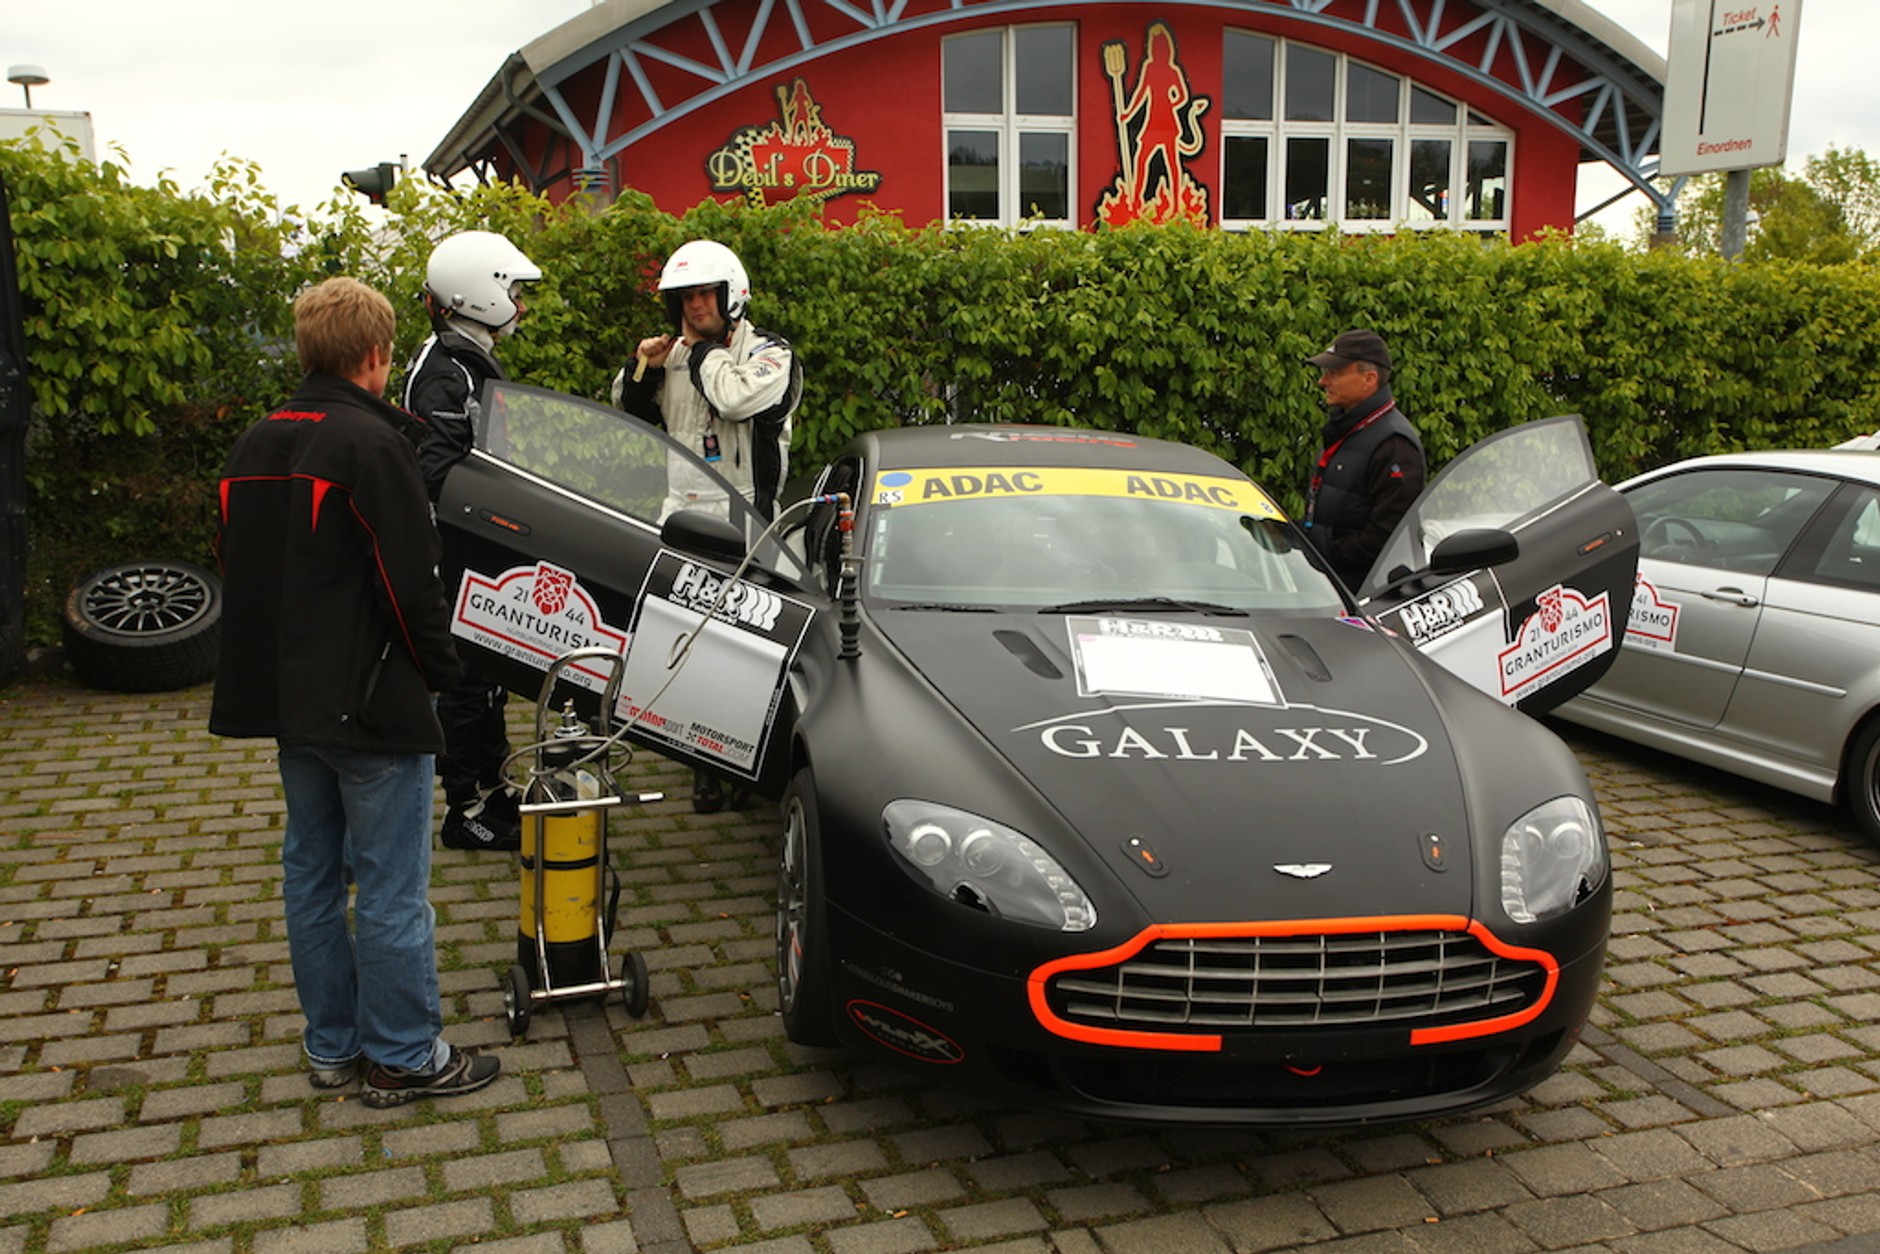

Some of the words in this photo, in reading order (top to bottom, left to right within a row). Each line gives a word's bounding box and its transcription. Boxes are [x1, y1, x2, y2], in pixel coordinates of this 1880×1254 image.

[1723, 8, 1757, 26] Ticket
[1696, 138, 1752, 156] Einordnen
[803, 148, 879, 188] Diner
[922, 472, 1044, 499] ADAC
[1126, 475, 1239, 508] ADAC
[470, 592, 613, 651] GRANTURISM
[514, 586, 529, 604] 21
[565, 608, 585, 627] 44
[1529, 628, 1541, 643] 21
[1565, 607, 1579, 622] 44
[1505, 612, 1603, 677] GRANTURISMO
[1516, 649, 1597, 698] www.granturismo.org
[690, 722, 755, 753] MOTORSPORT
[1040, 724, 1378, 761] GALAXY
